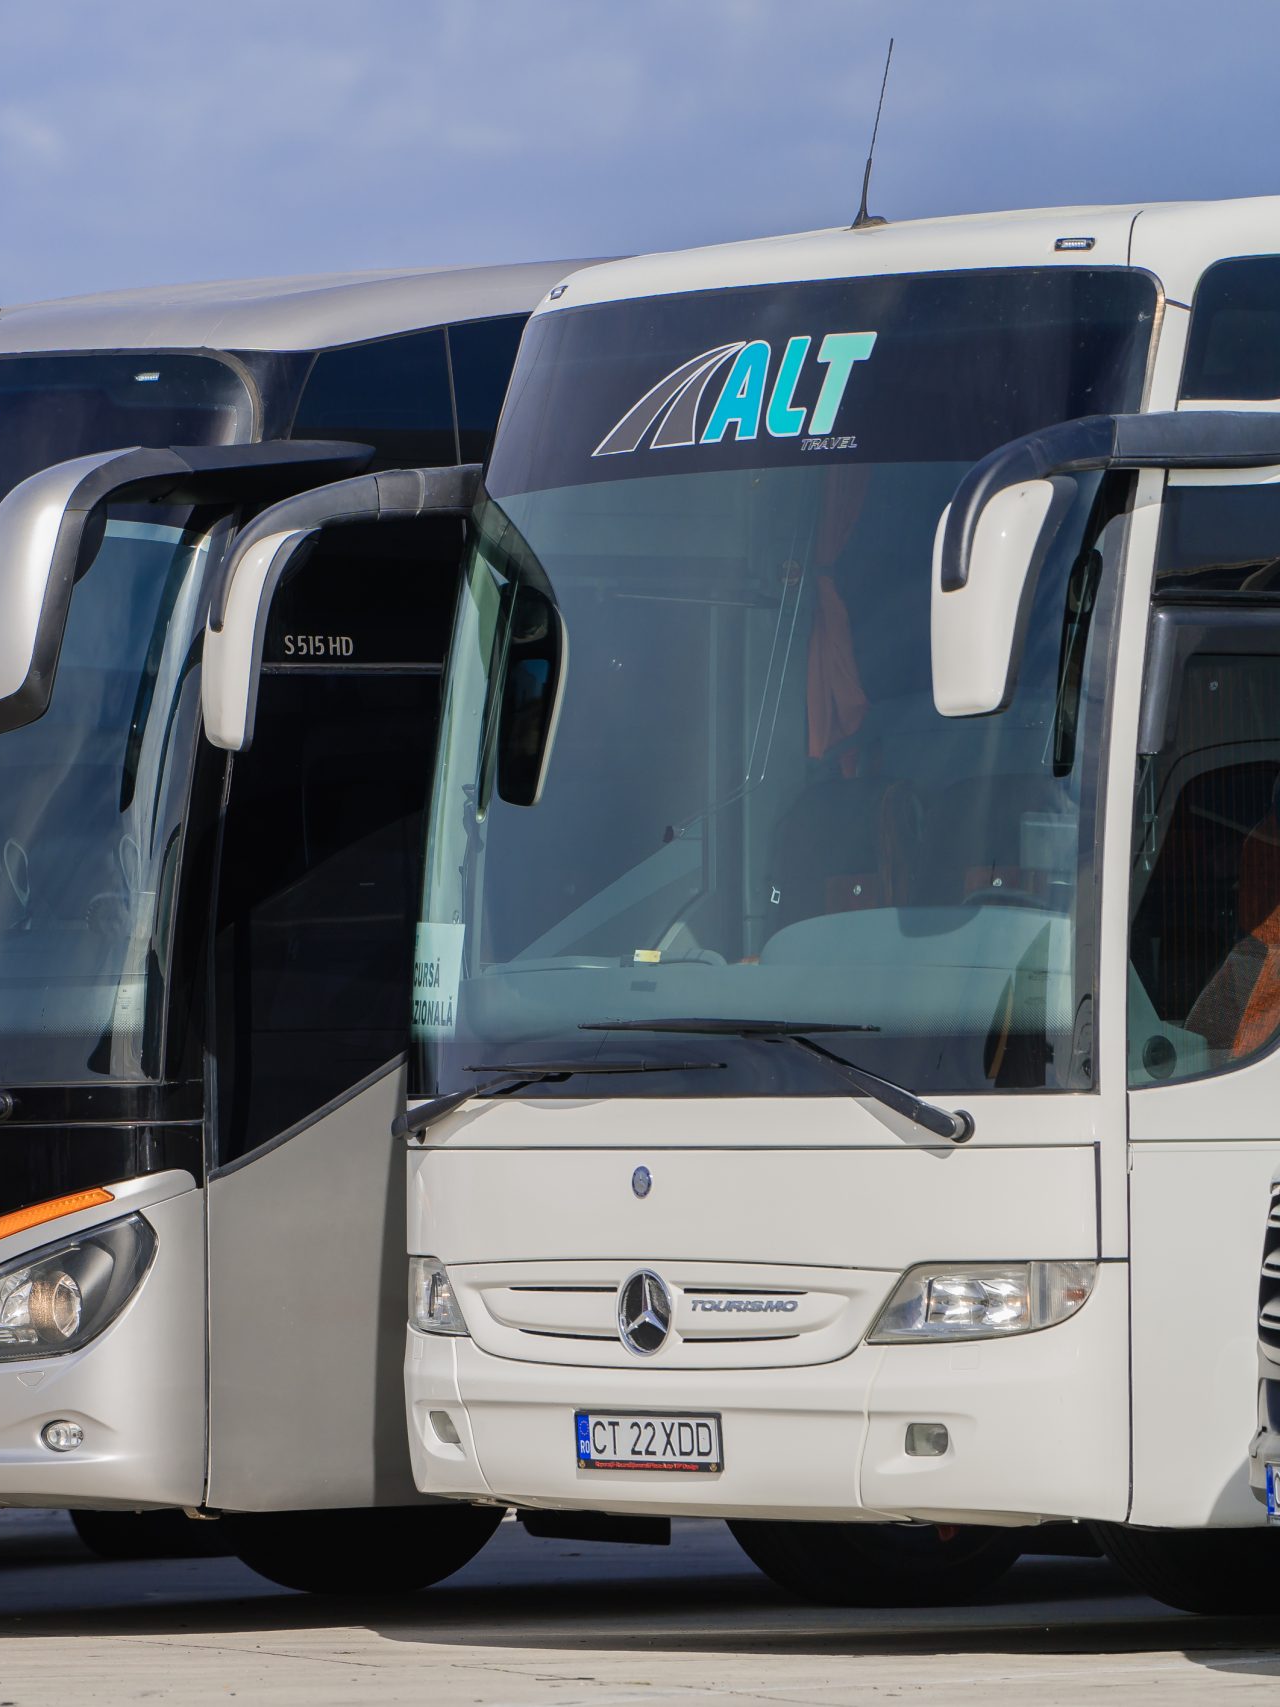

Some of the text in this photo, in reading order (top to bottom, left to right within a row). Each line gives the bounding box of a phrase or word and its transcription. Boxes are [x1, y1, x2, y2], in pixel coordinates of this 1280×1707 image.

[699, 331, 878, 445] ALT
[800, 436, 858, 451] TRAVEL
[411, 995, 453, 1027] ZIONALĂ
[691, 1299, 799, 1313] TOURISMO
[580, 1439, 590, 1454] RO
[592, 1420, 620, 1456] CT
